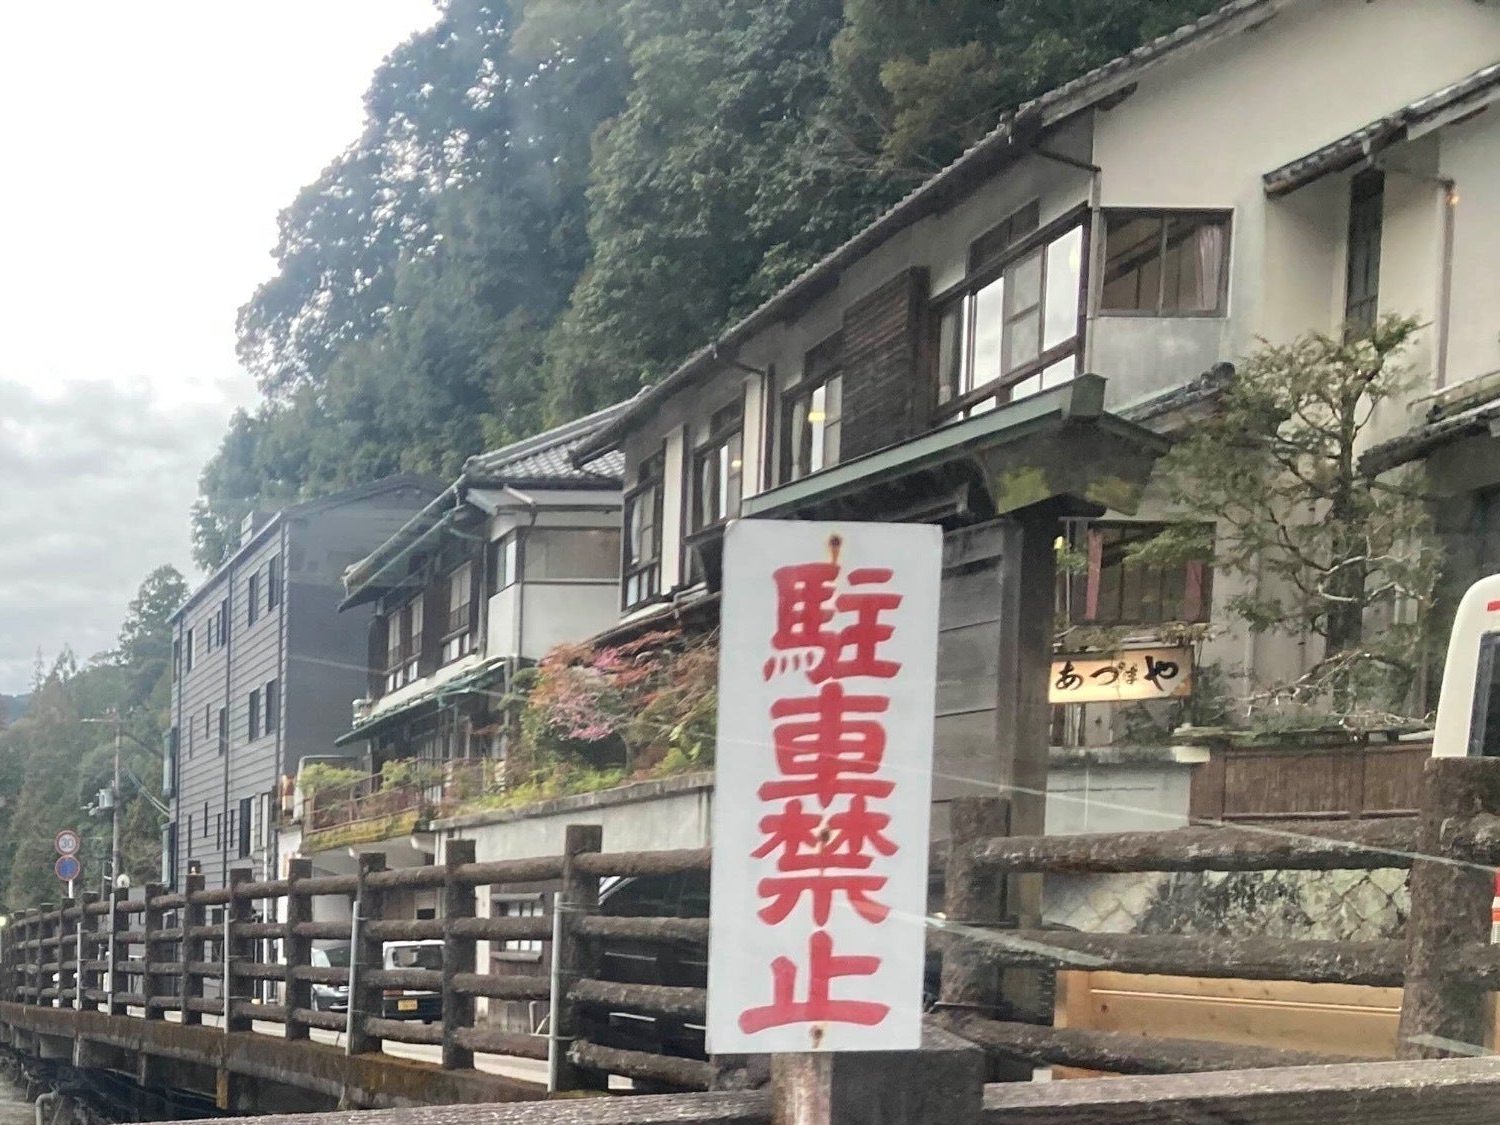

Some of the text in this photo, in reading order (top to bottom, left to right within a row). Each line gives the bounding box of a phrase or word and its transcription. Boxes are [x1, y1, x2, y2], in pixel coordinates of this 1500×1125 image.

[60, 837, 75, 849] 30
[738, 562, 904, 1035] 駐車禁止
